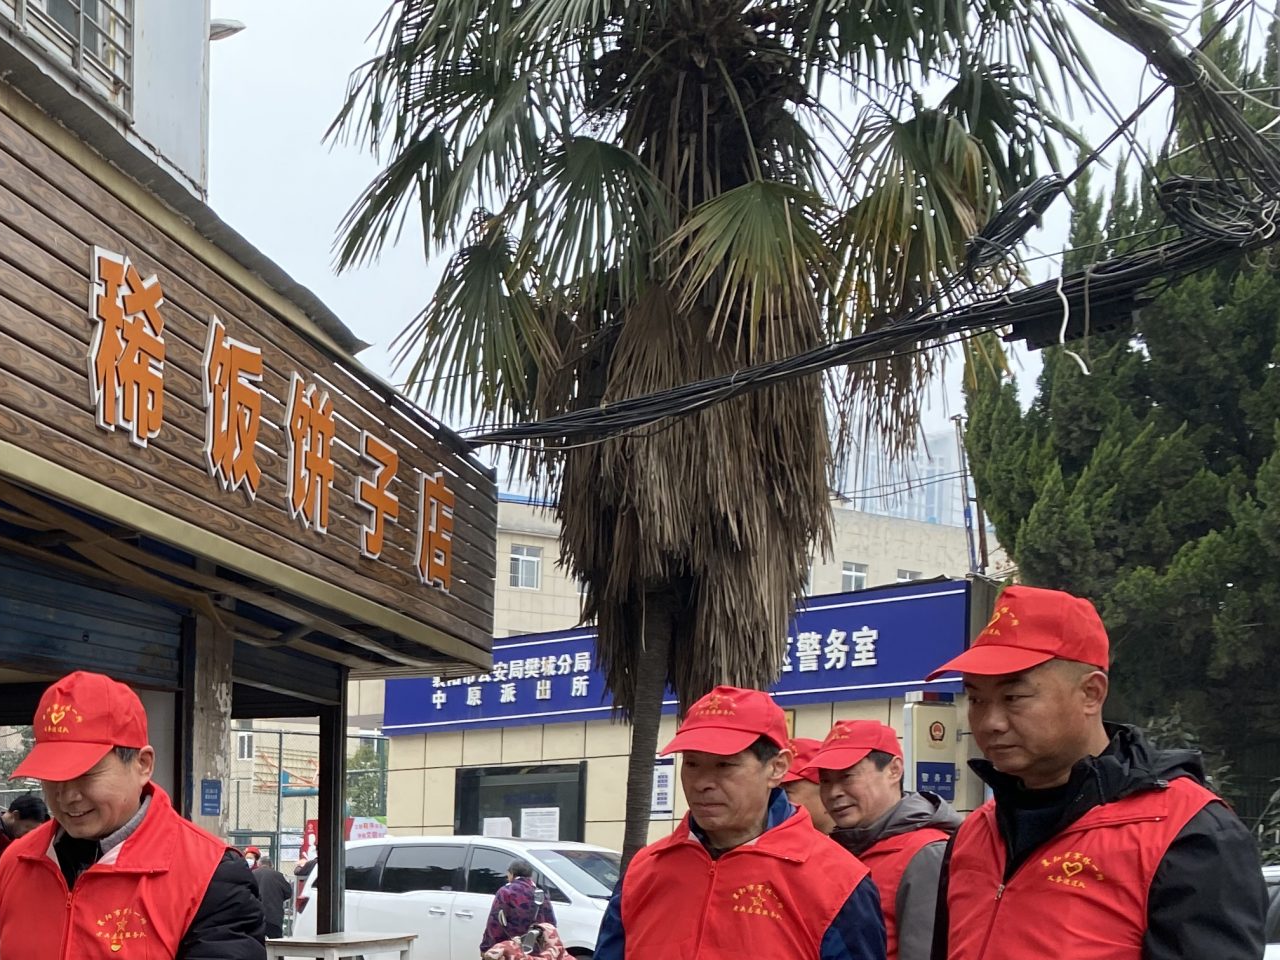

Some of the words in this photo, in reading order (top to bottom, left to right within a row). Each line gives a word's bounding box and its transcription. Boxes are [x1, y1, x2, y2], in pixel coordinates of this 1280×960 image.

[87, 245, 455, 593] 稀饭饼子店
[432, 675, 590, 710] 中原派出所
